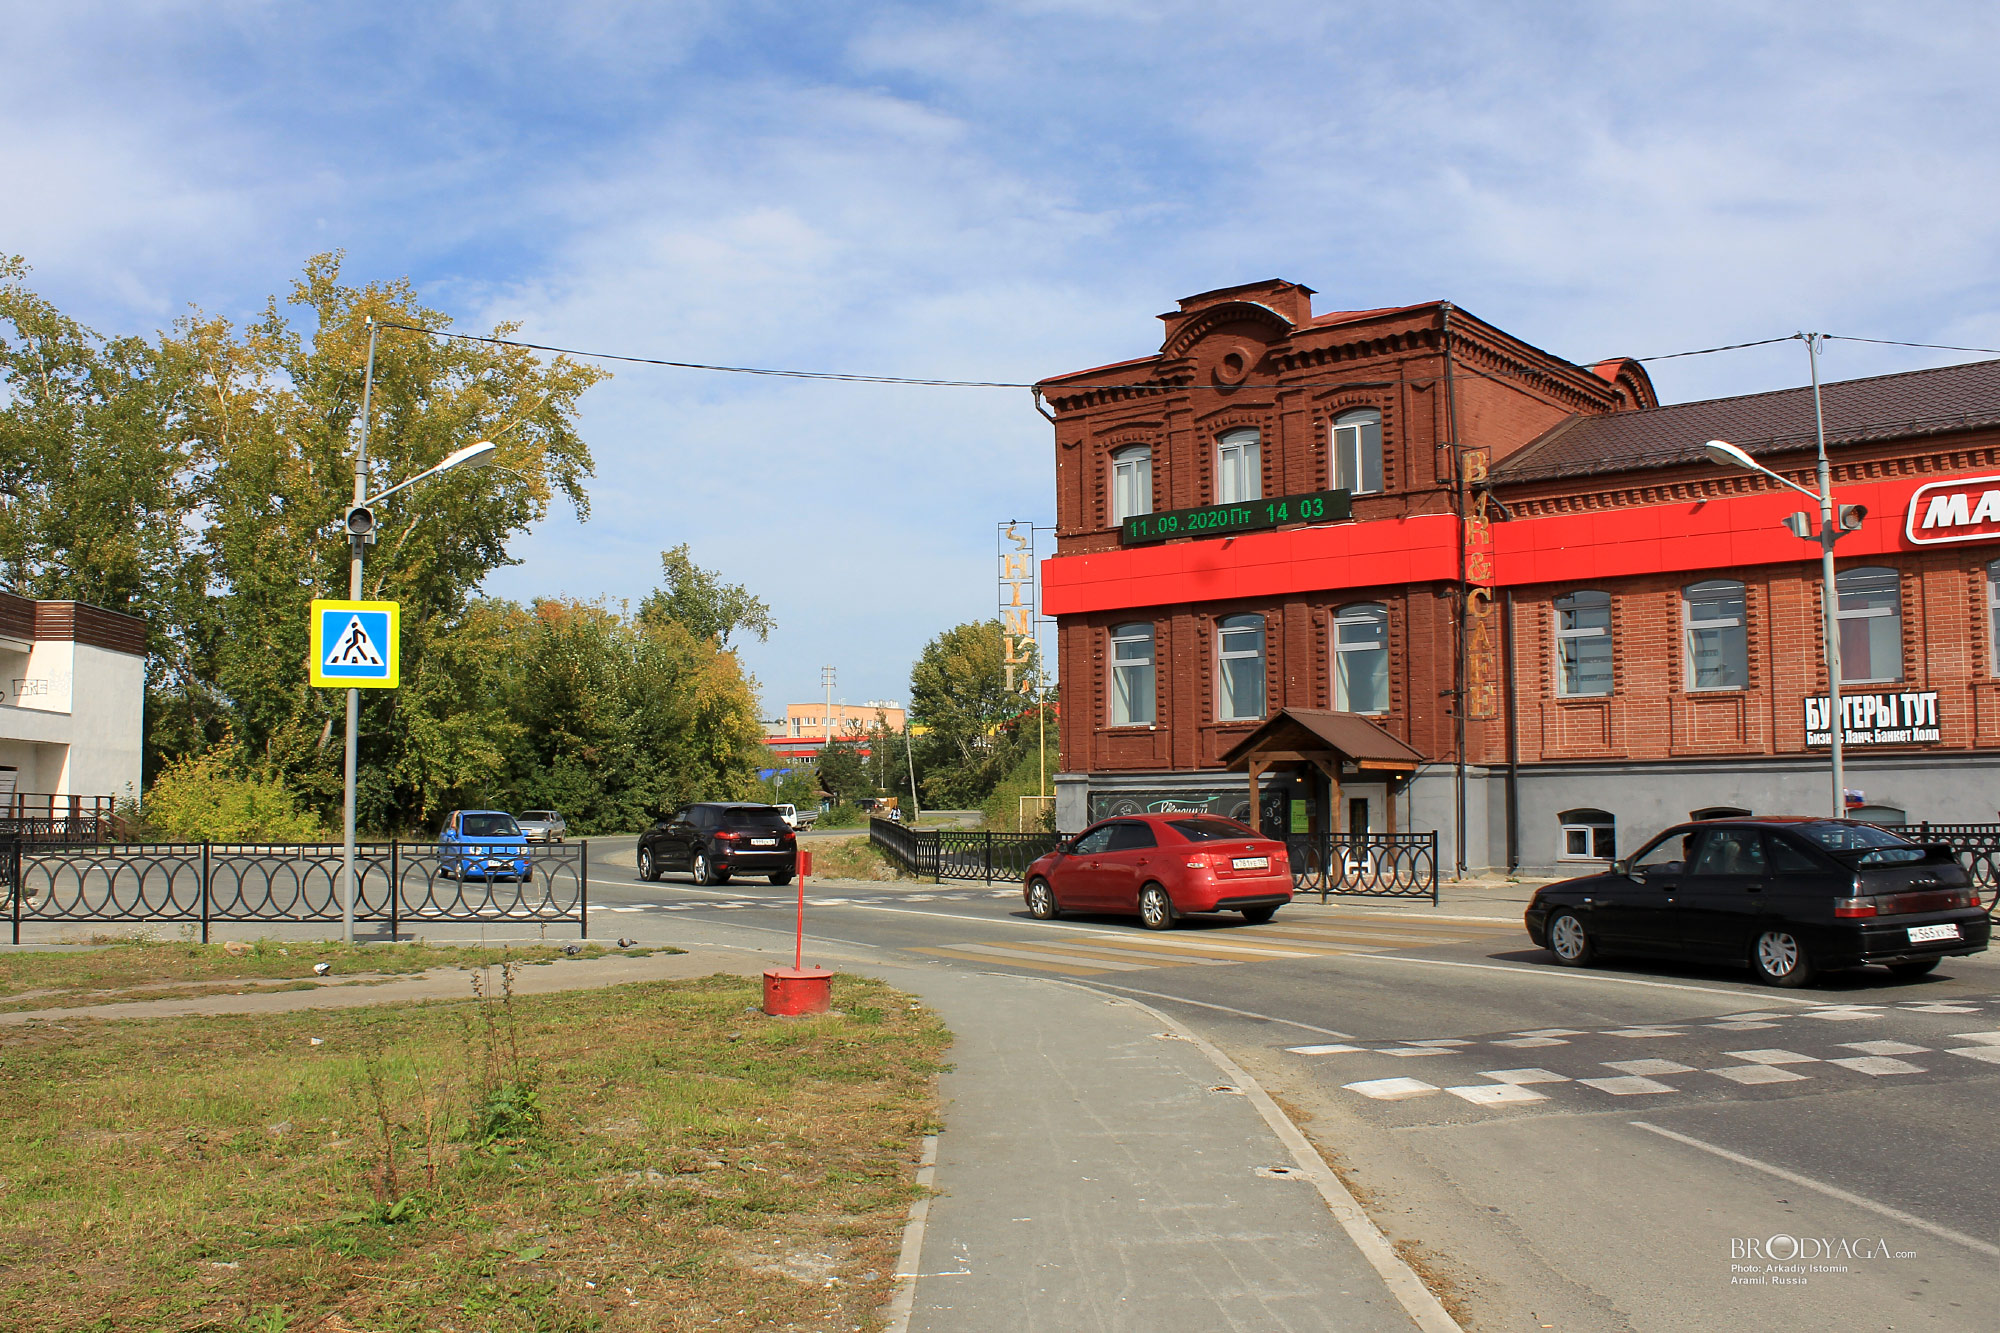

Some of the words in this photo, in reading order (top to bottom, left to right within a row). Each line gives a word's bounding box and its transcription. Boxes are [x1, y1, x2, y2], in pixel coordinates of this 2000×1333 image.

[1266, 503, 1288, 523] 14
[1300, 498, 1324, 518] 03
[1467, 587, 1494, 716] CAFE
[1805, 695, 1898, 730] БУГЕРЫ
[1900, 692, 1937, 726] ТУТ
[1874, 728, 1911, 743] Банкет
[1912, 727, 1939, 741] Холл
